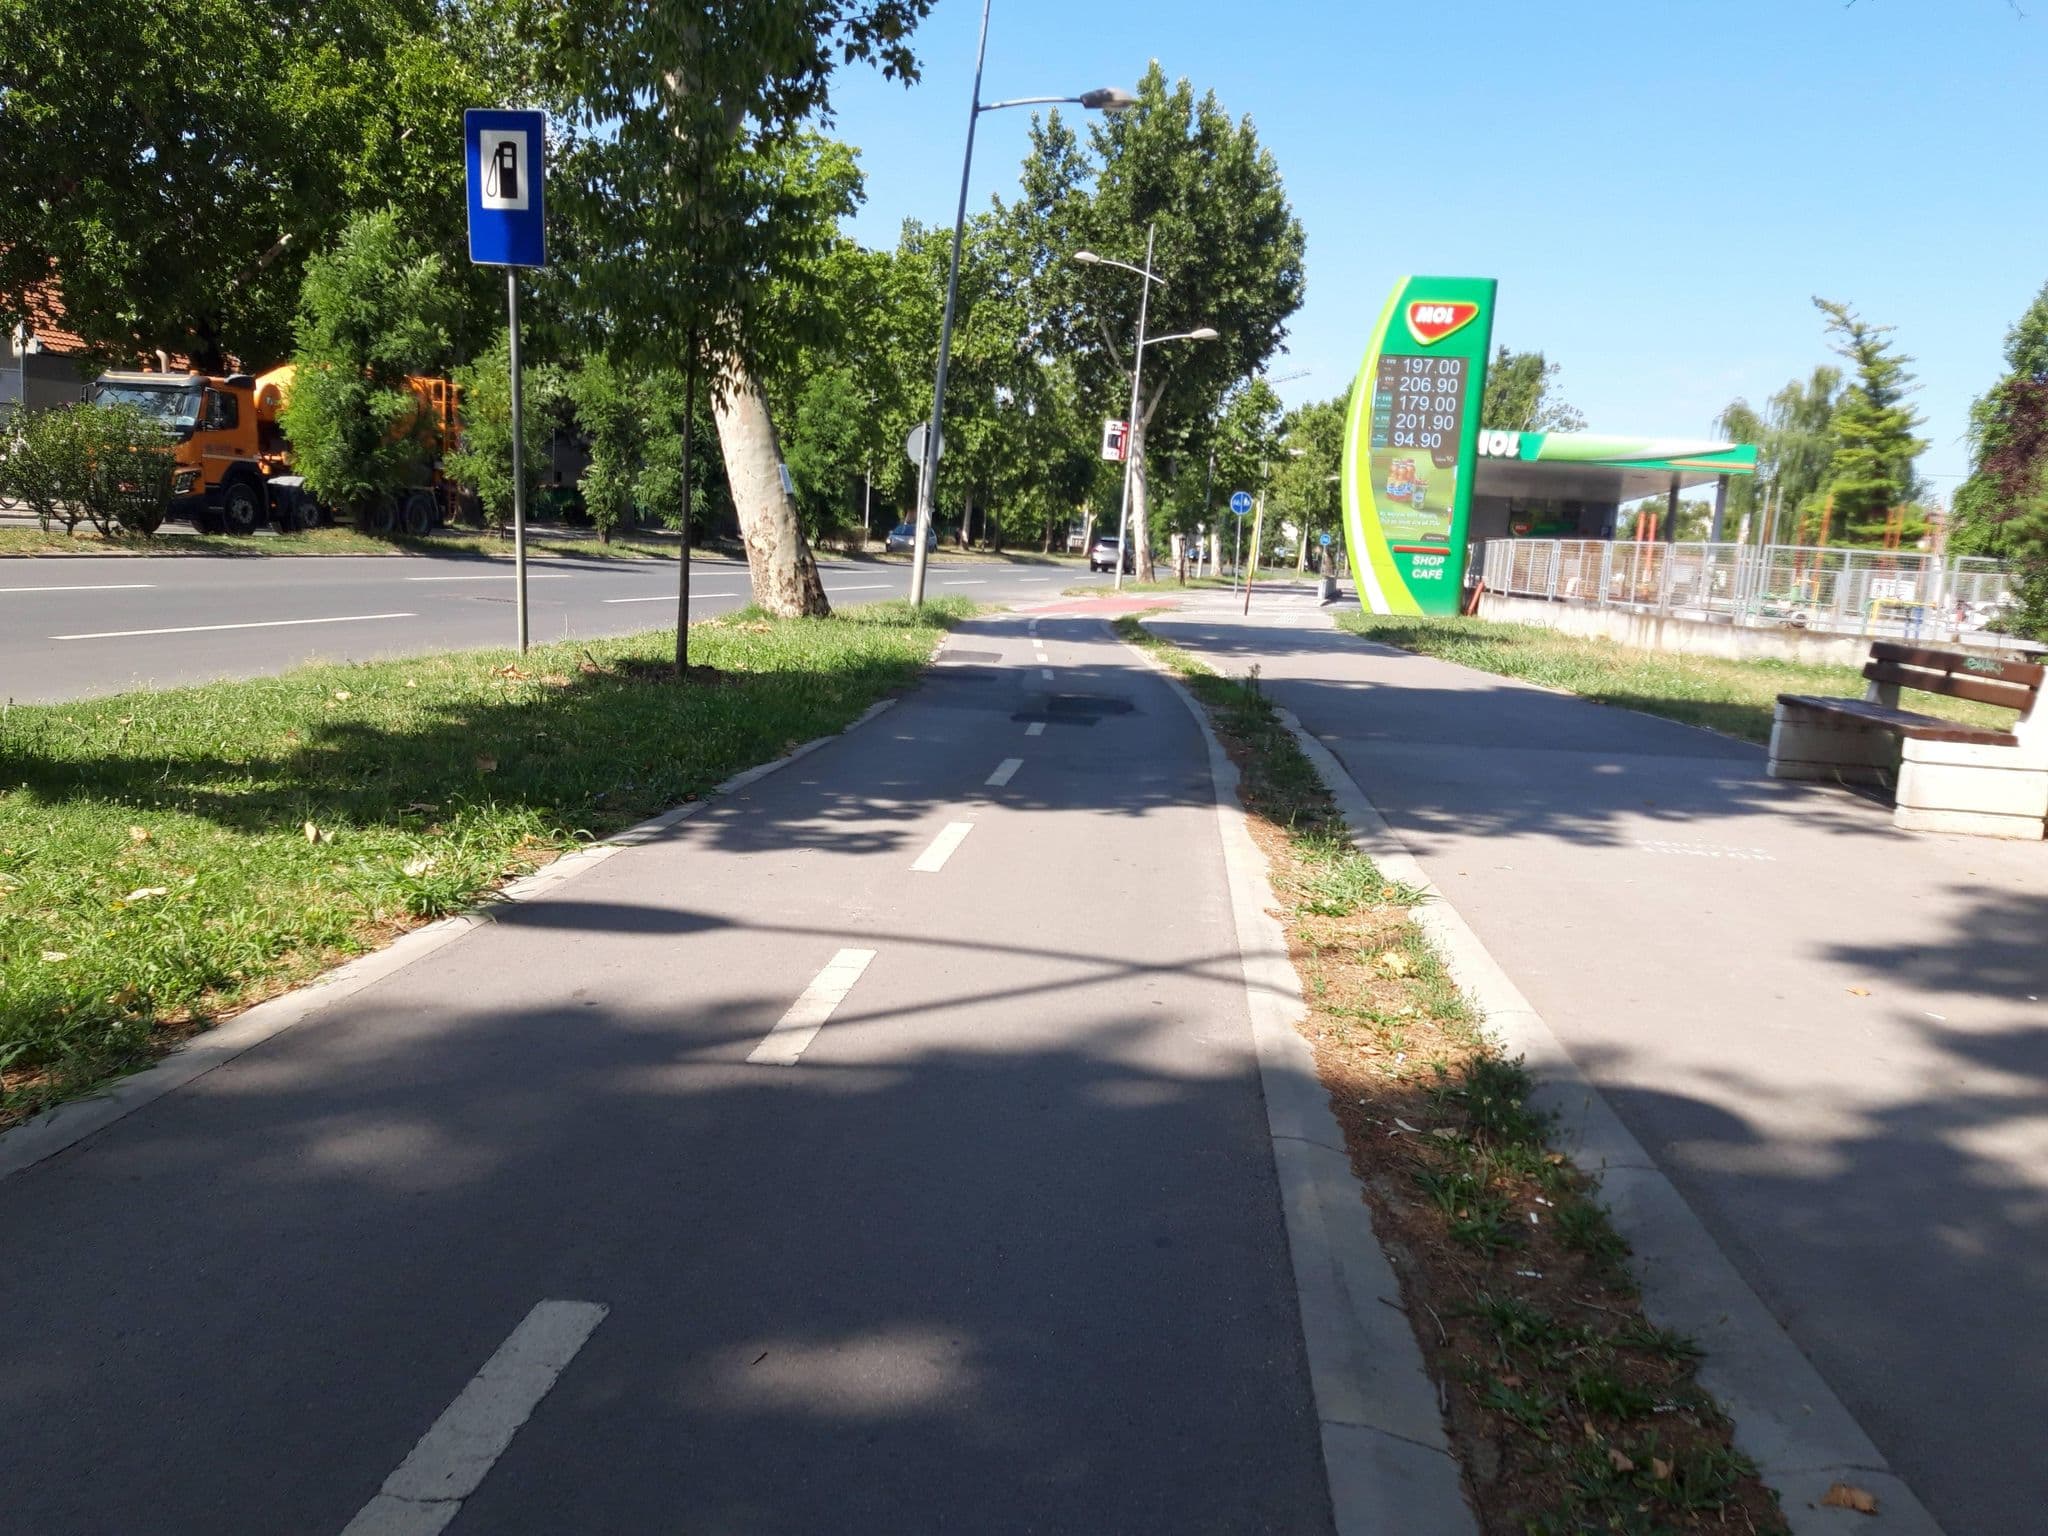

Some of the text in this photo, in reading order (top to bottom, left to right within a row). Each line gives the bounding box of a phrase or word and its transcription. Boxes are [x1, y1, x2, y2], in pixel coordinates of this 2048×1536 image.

[1416, 306, 1454, 324] MOL
[1403, 358, 1460, 375] 197.00
[1399, 376, 1458, 393] 206.90
[1400, 395, 1456, 412] 179.00
[1395, 413, 1454, 430] 201.90
[1394, 431, 1441, 448] 94.90
[1412, 554, 1445, 566] SHOP
